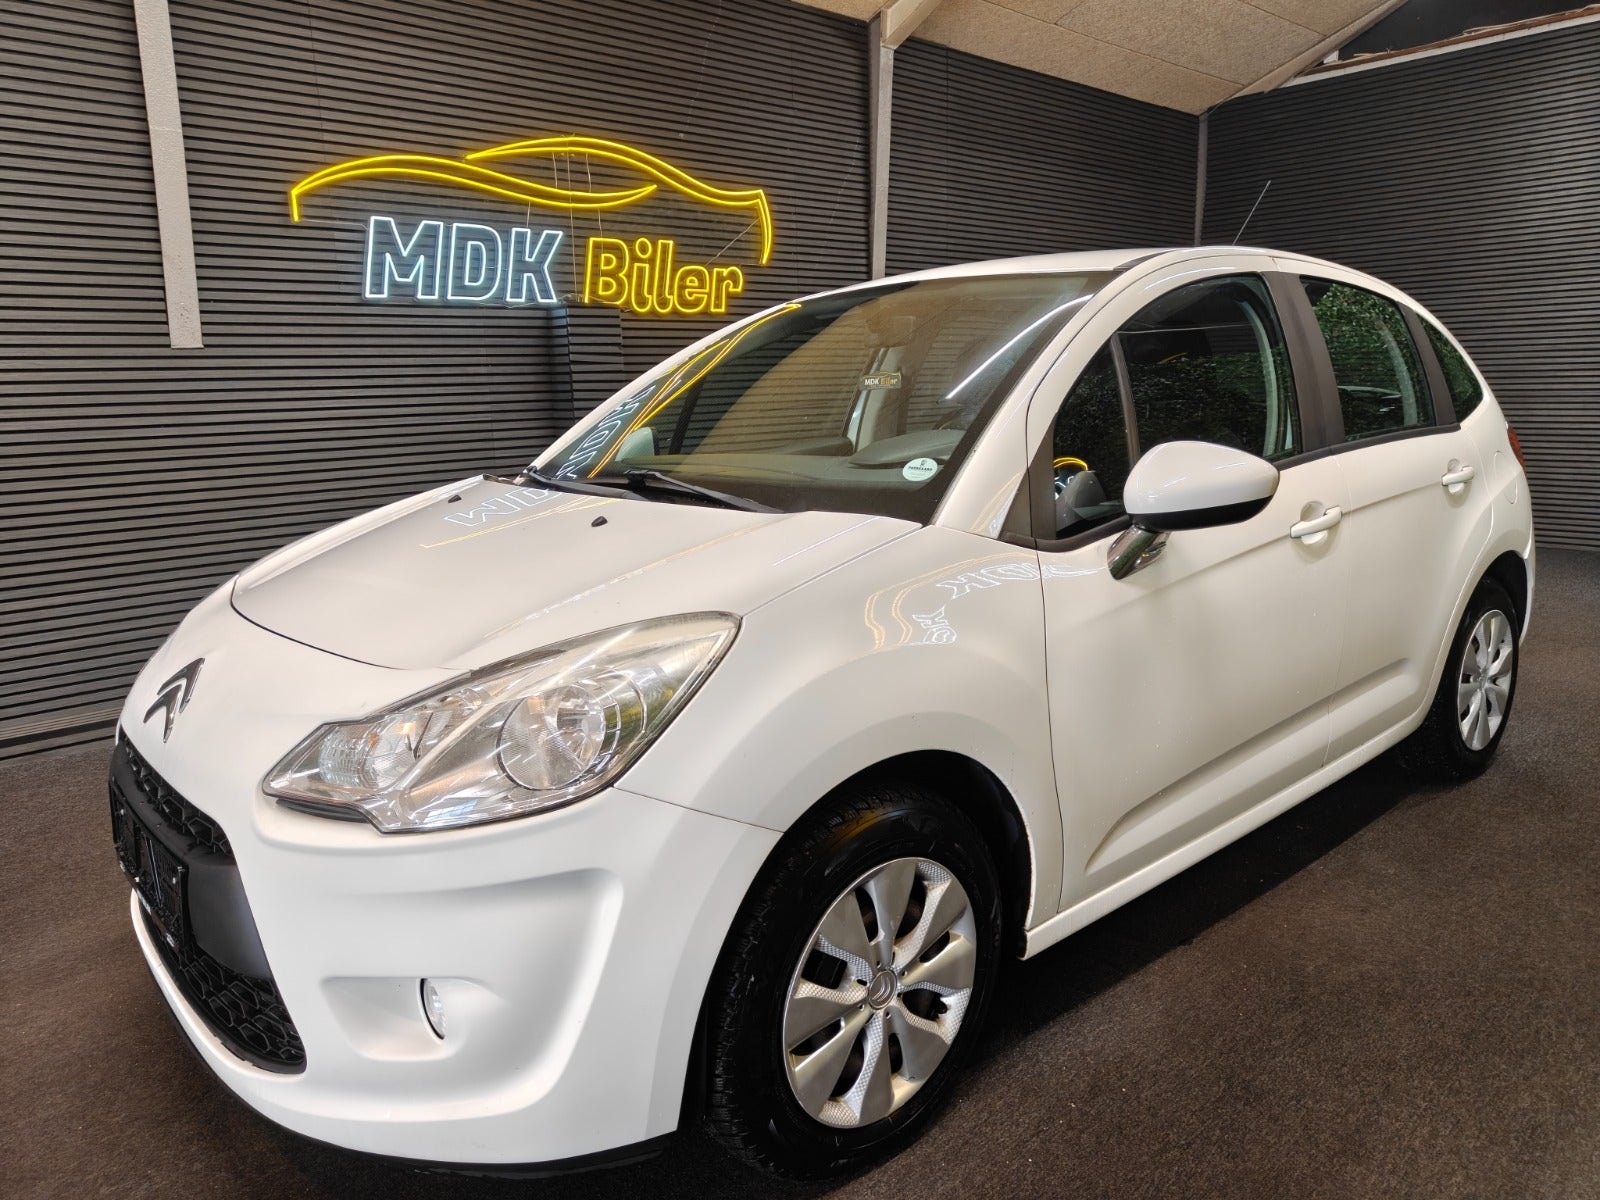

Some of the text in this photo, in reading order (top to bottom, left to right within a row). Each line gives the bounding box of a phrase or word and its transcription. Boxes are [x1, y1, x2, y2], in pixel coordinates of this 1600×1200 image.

[364, 215, 745, 314] MDK Biler
[864, 377, 880, 386] MDK
